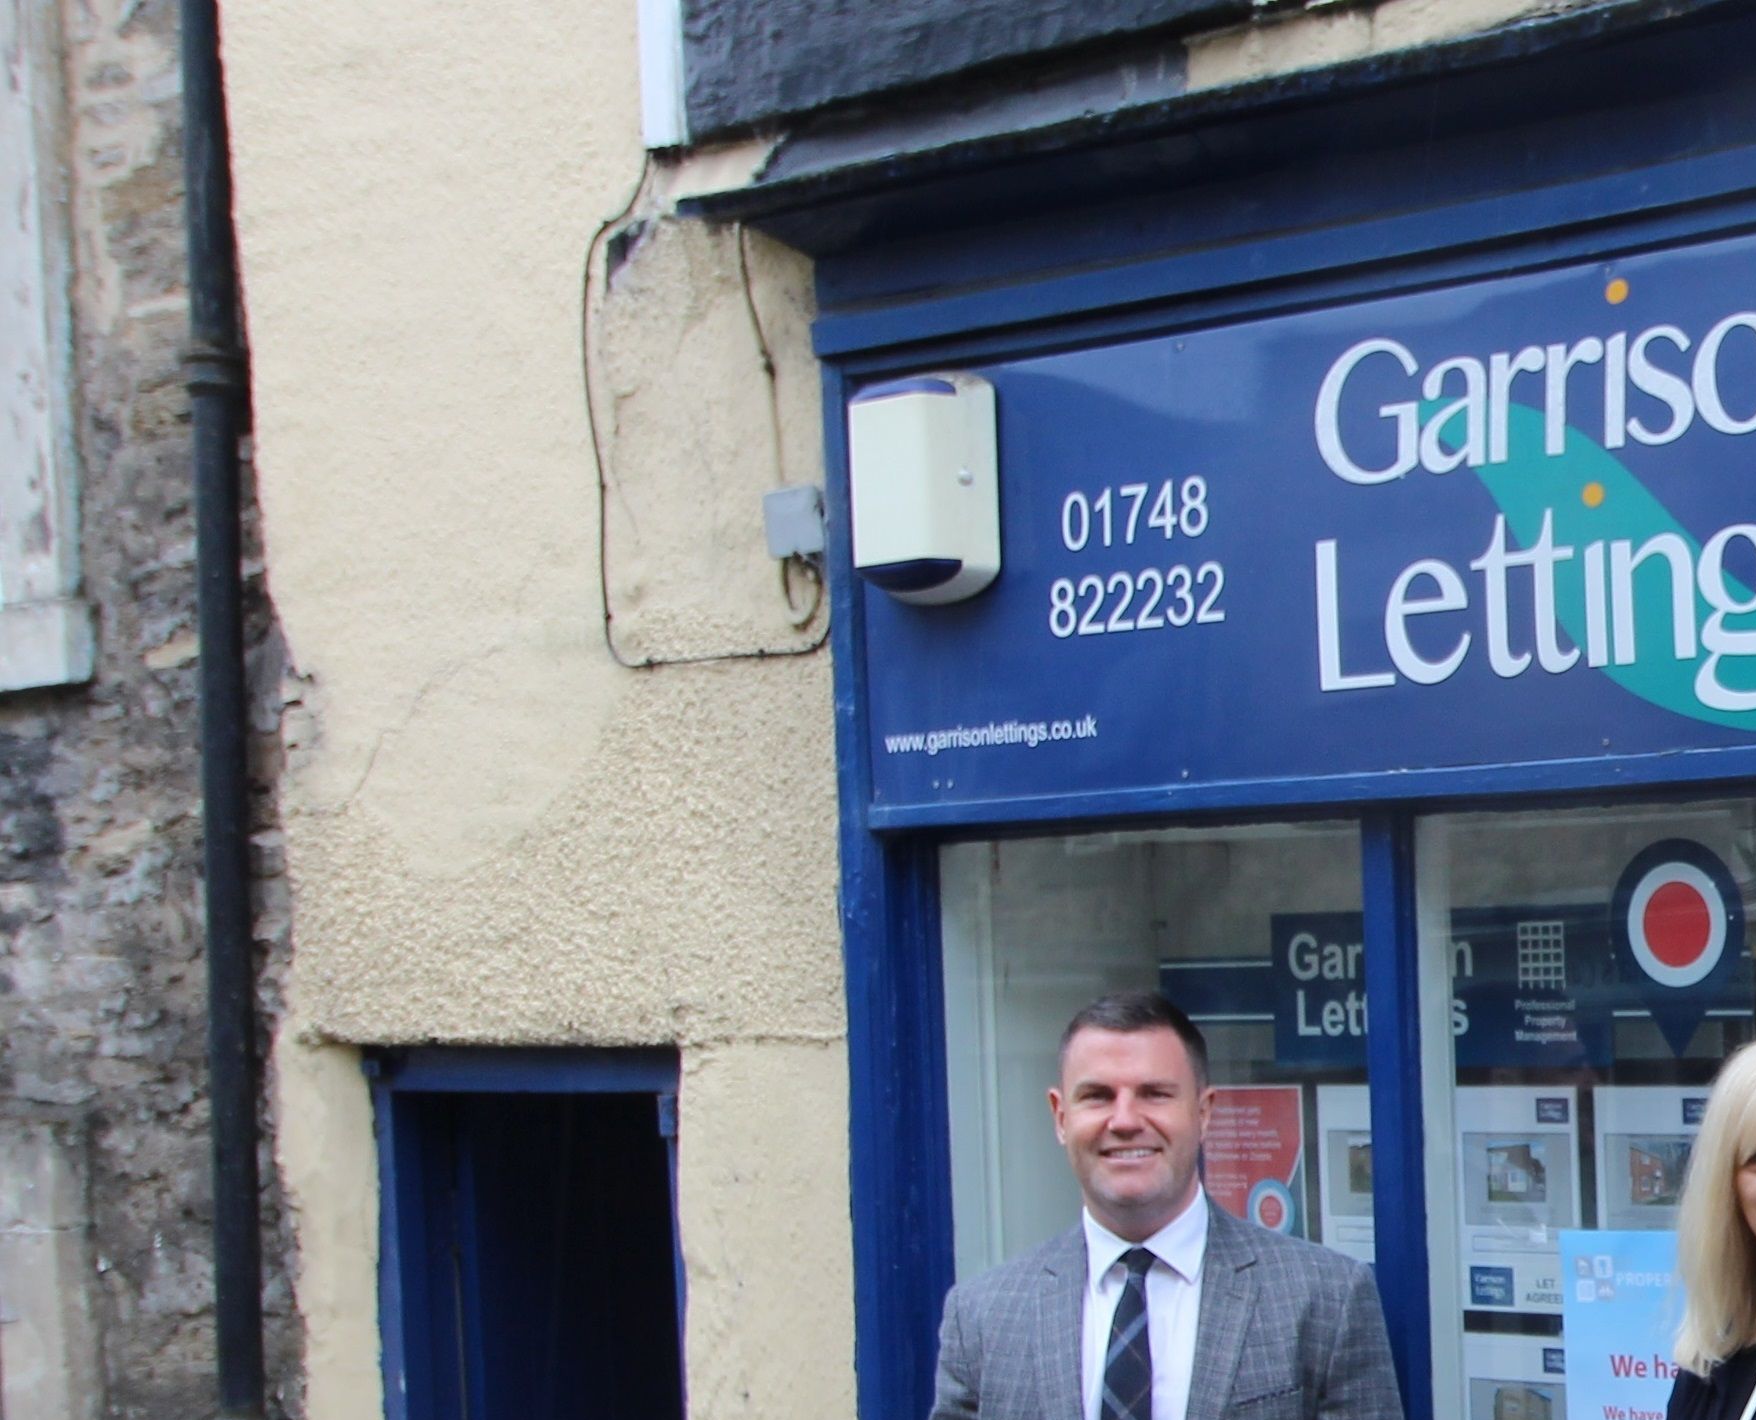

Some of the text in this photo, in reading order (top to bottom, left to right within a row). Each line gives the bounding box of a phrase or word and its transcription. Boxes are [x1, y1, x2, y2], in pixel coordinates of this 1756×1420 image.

[1061, 475, 1210, 552] 01748
[1049, 561, 1226, 639] 822232
[886, 714, 1098, 755] www.garrisonlettings.co.uk
[1536, 1278, 1555, 1290] LET
[1615, 1271, 1672, 1287] PROPER
[1610, 1353, 1681, 1380] We ha
